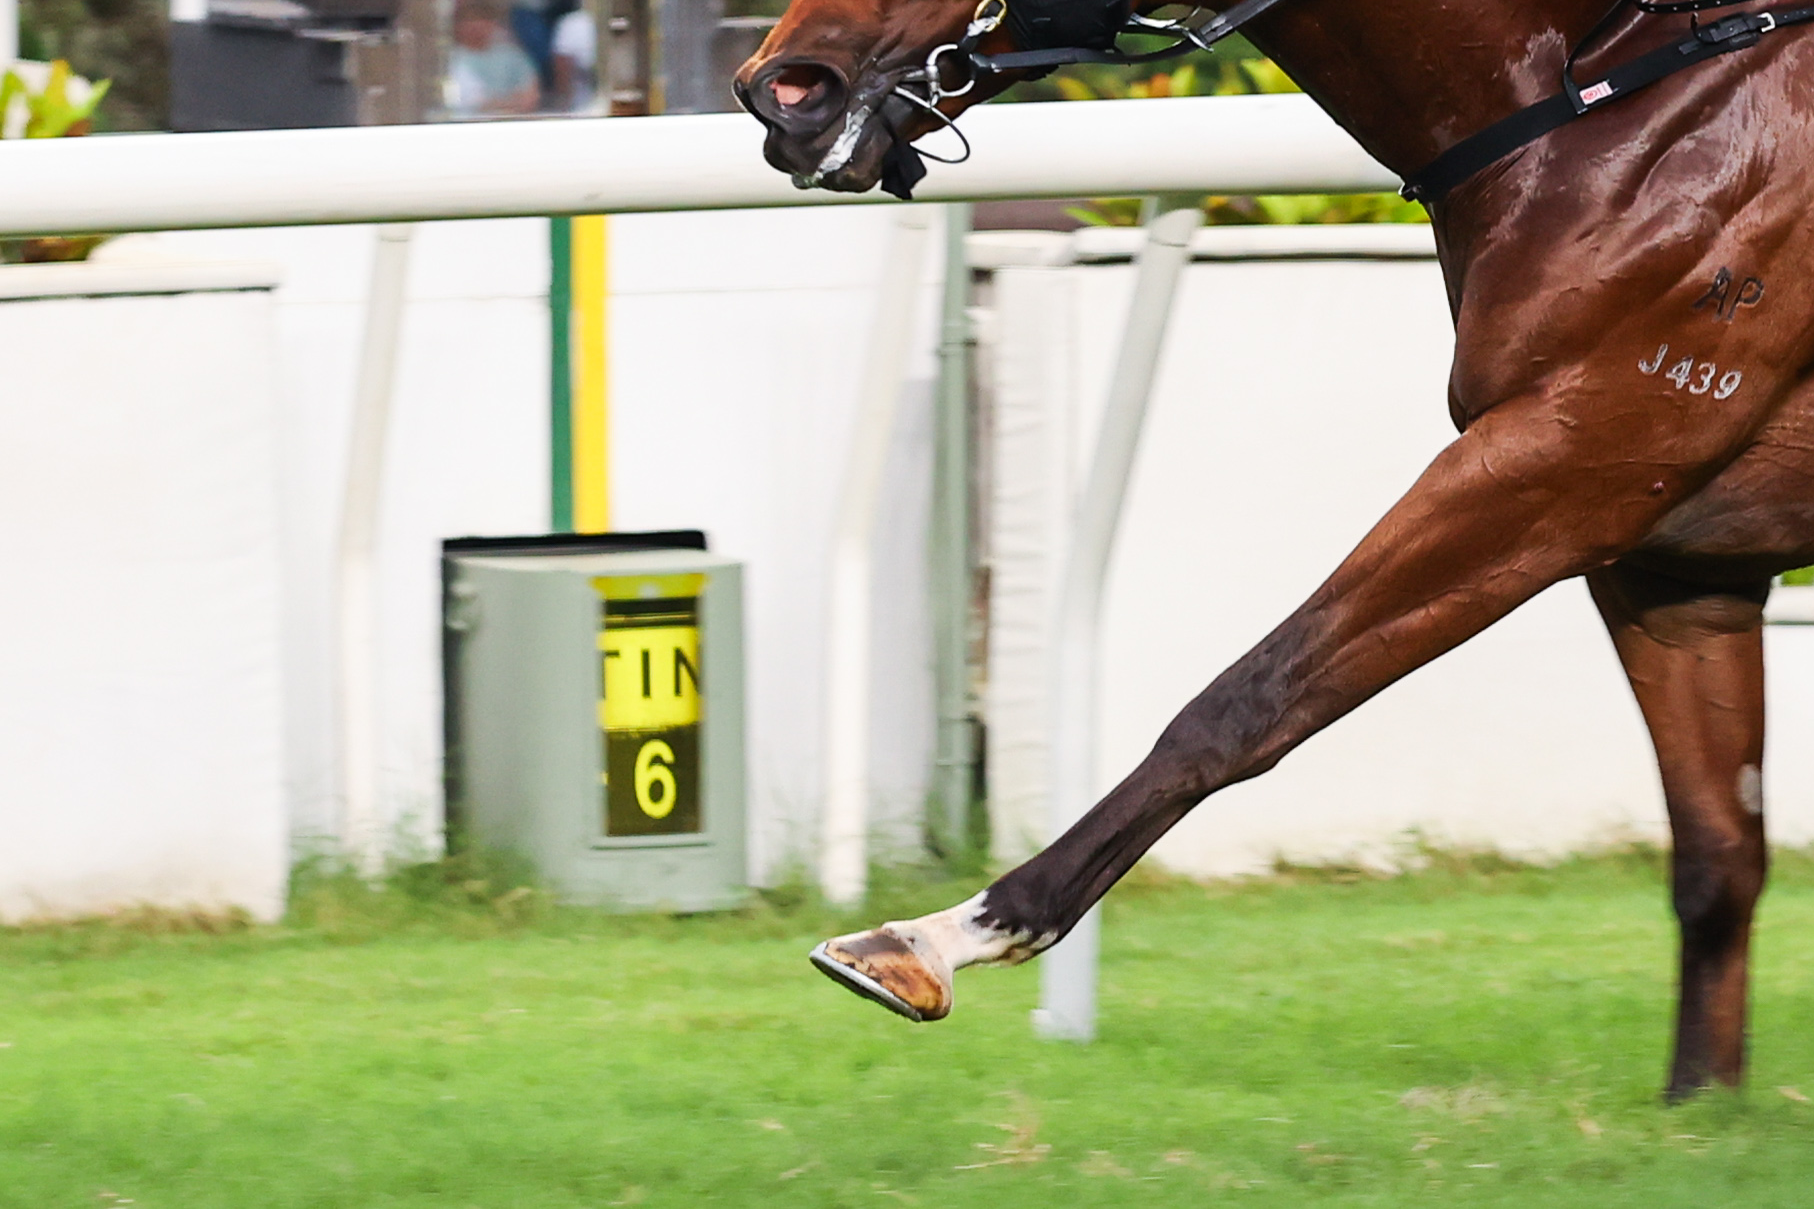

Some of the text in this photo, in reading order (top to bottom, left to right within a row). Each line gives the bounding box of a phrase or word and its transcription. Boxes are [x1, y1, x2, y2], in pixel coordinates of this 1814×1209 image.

[1692, 266, 1764, 323] AP
[1637, 343, 1742, 399] J439
[634, 739, 677, 819] 6
